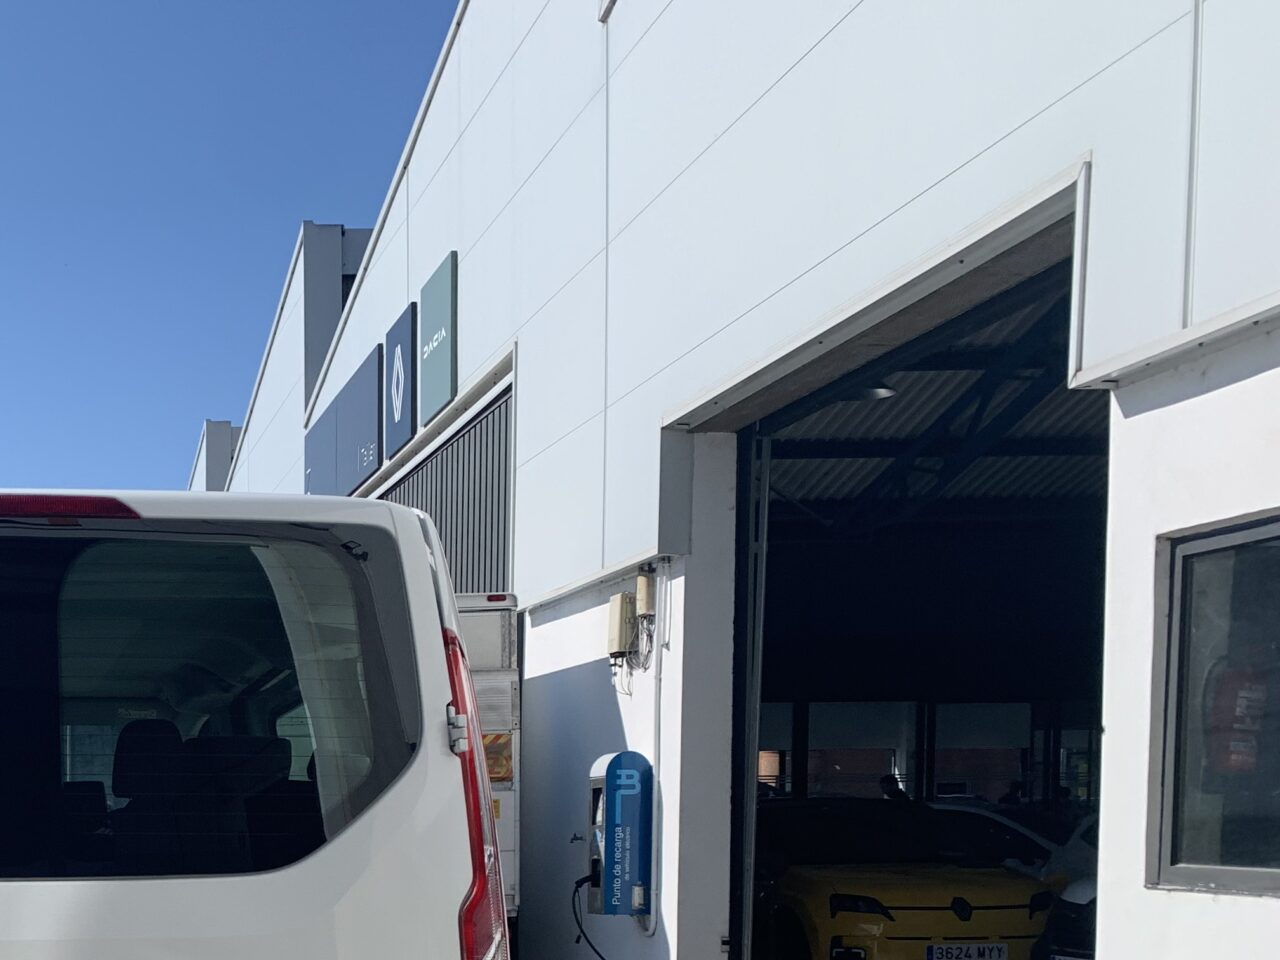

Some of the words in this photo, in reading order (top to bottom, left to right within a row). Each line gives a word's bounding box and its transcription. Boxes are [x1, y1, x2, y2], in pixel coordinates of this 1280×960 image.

[423, 327, 447, 360] DACIA
[614, 826, 624, 862] recarga
[612, 864, 621, 876] de
[612, 878, 621, 905] Punto
[936, 946, 972, 960] 3624
[977, 946, 1004, 958] MYY
